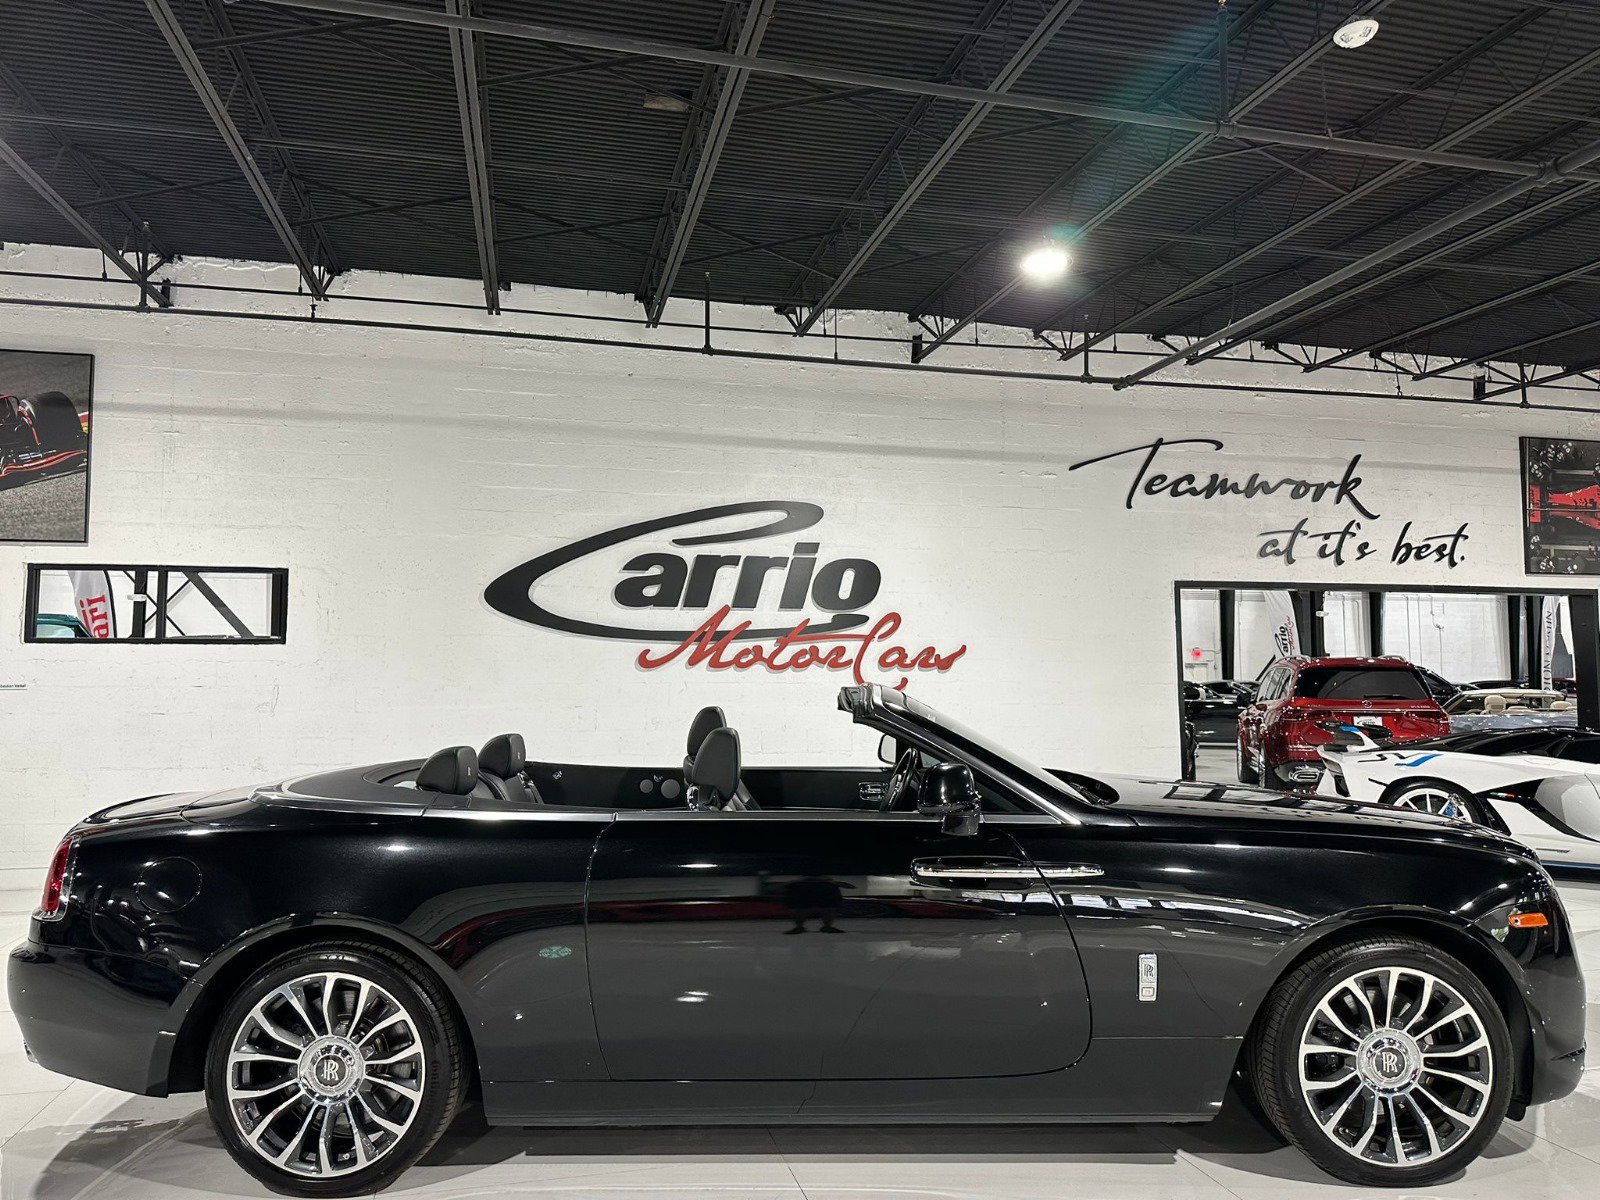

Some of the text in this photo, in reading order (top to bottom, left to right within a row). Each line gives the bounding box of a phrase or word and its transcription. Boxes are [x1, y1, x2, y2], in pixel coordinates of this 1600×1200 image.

[1068, 437, 1381, 520] Teamwork
[483, 500, 882, 641] Carrio
[1259, 517, 1469, 568] at it's best.
